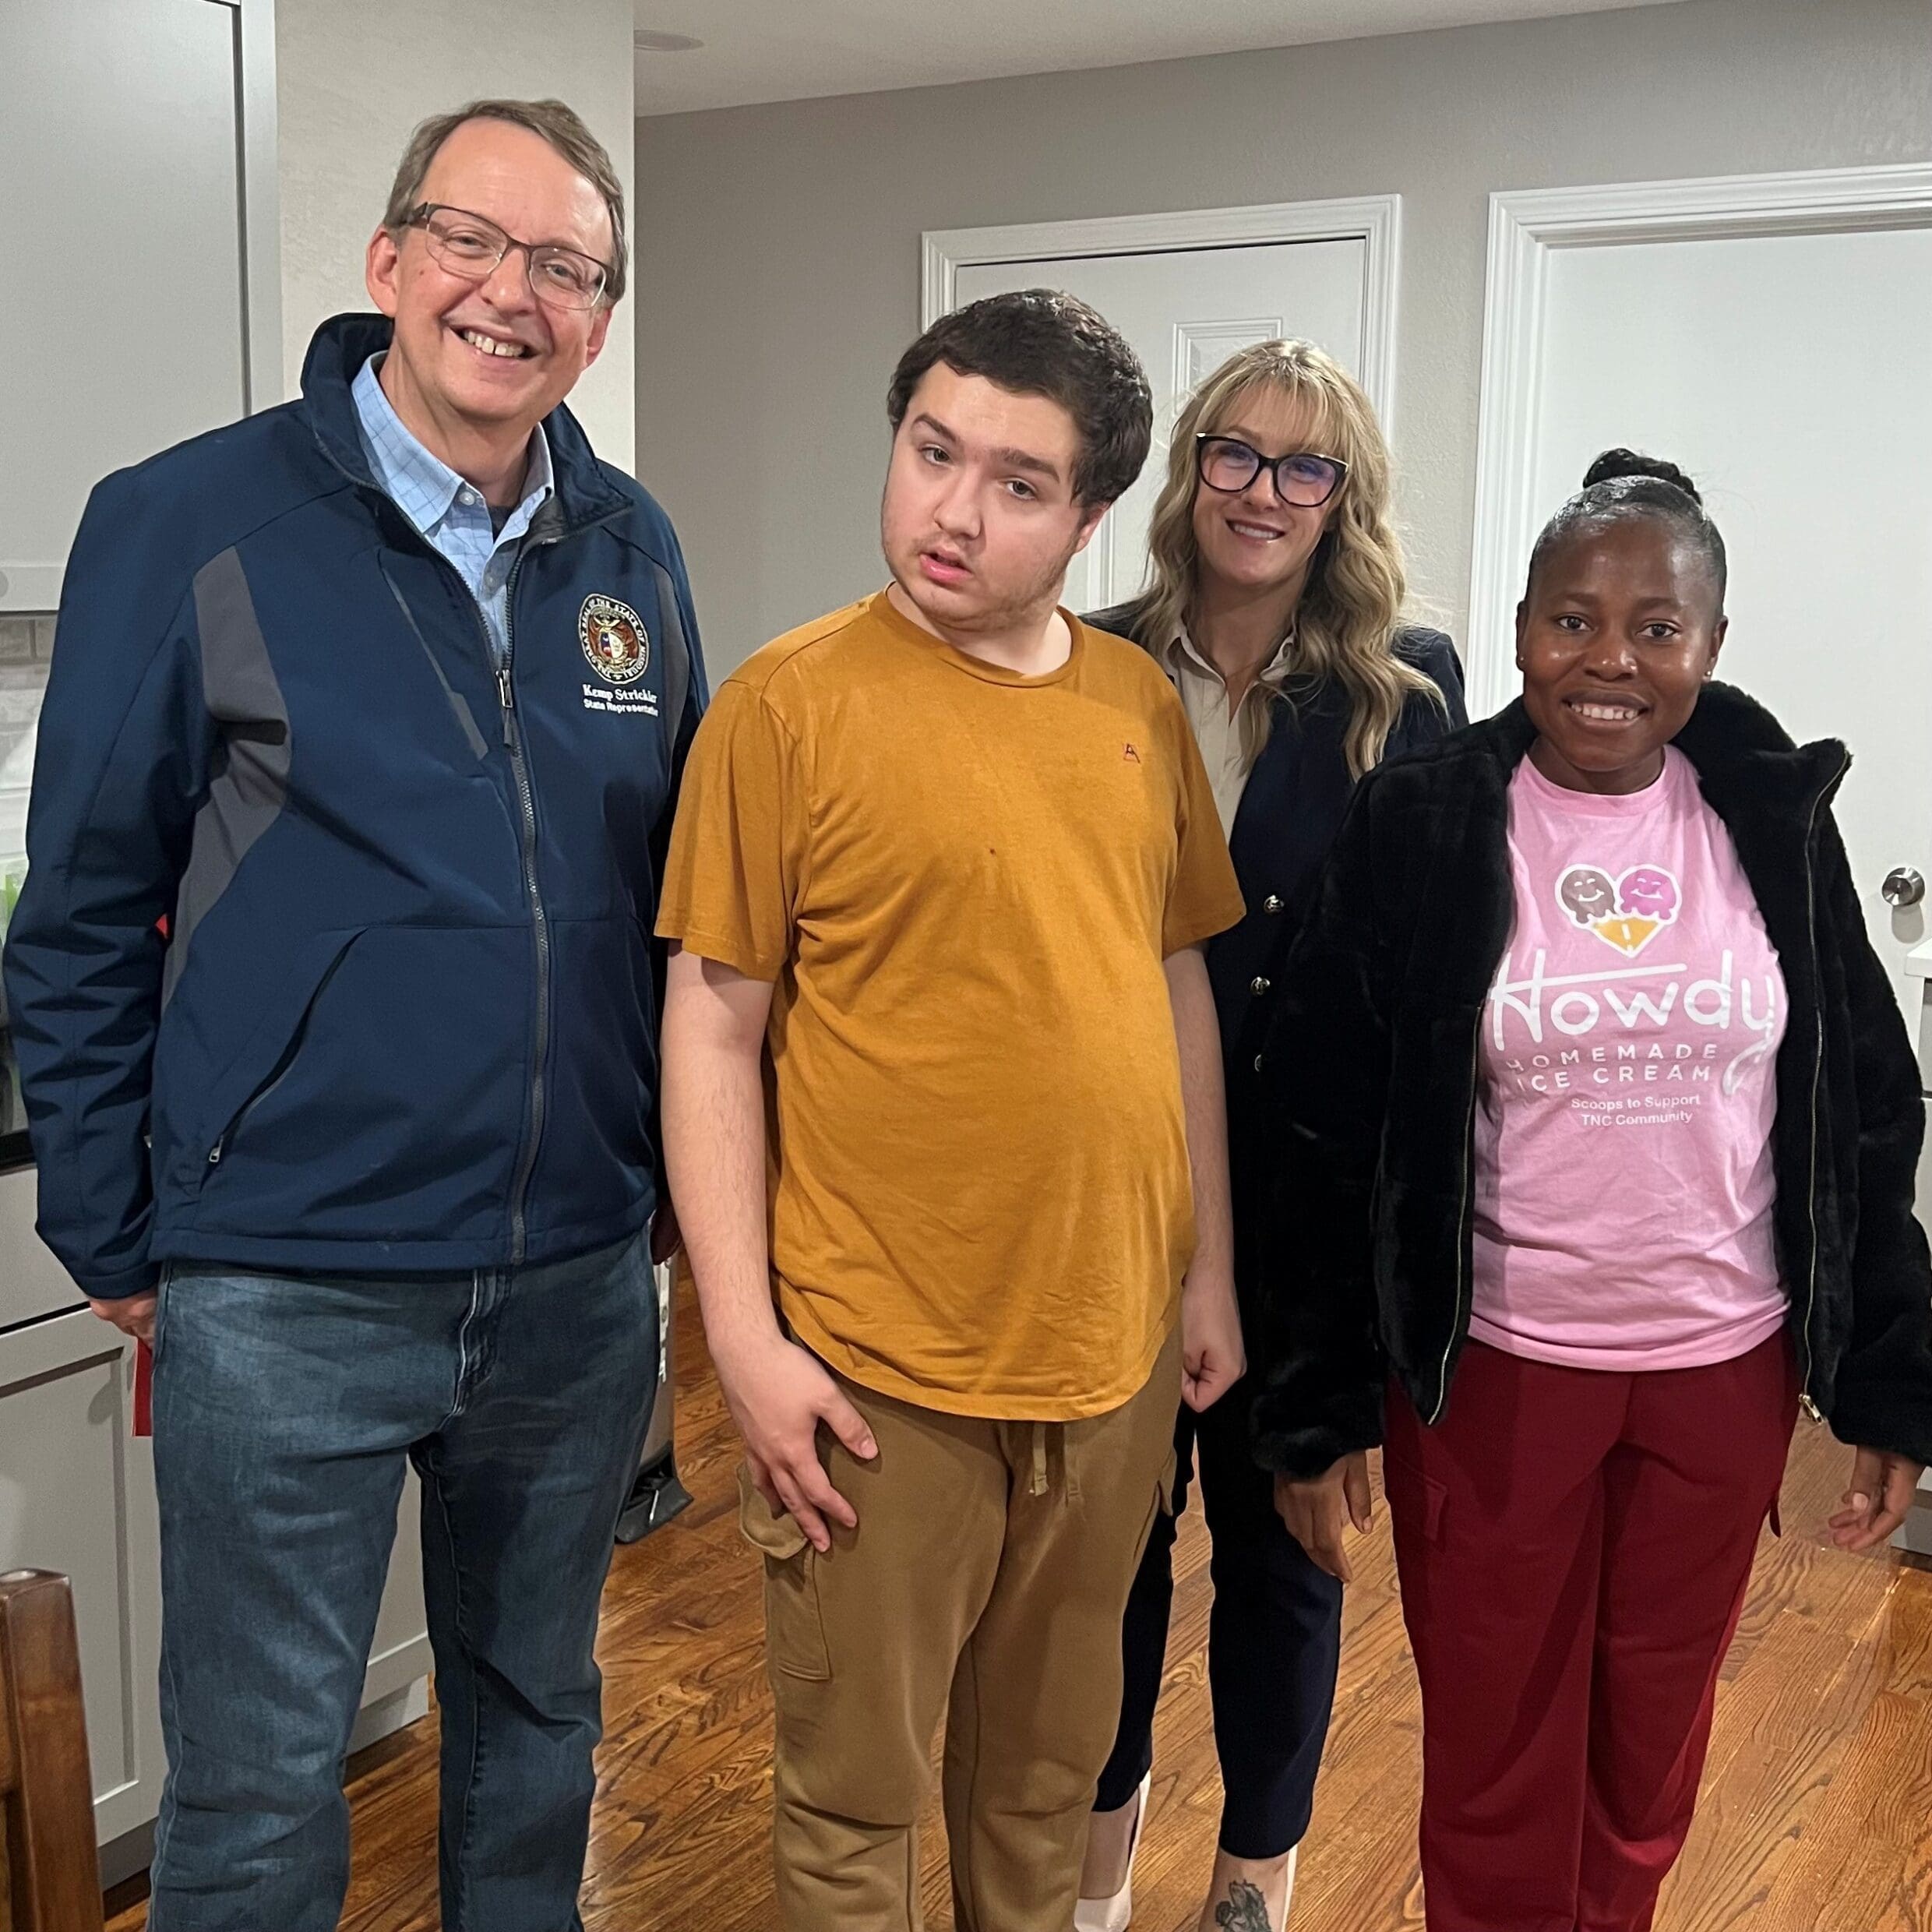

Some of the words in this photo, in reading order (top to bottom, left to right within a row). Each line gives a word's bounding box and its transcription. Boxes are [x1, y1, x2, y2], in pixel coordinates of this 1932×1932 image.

[615, 604, 639, 627] STATE
[583, 684, 614, 702] Kemp
[583, 698, 606, 710] State
[1491, 948, 1775, 1096] Howdy
[1506, 1042, 1719, 1073] HOMEMADE
[1516, 1070, 1571, 1092] ICE
[1592, 1064, 1711, 1084] CREAM
[1571, 1097, 1624, 1112] Scoops
[1627, 1097, 1641, 1109] to
[1644, 1094, 1701, 1108] Support
[1581, 1114, 1613, 1127] TNC
[1615, 1110, 1694, 1126] Community
